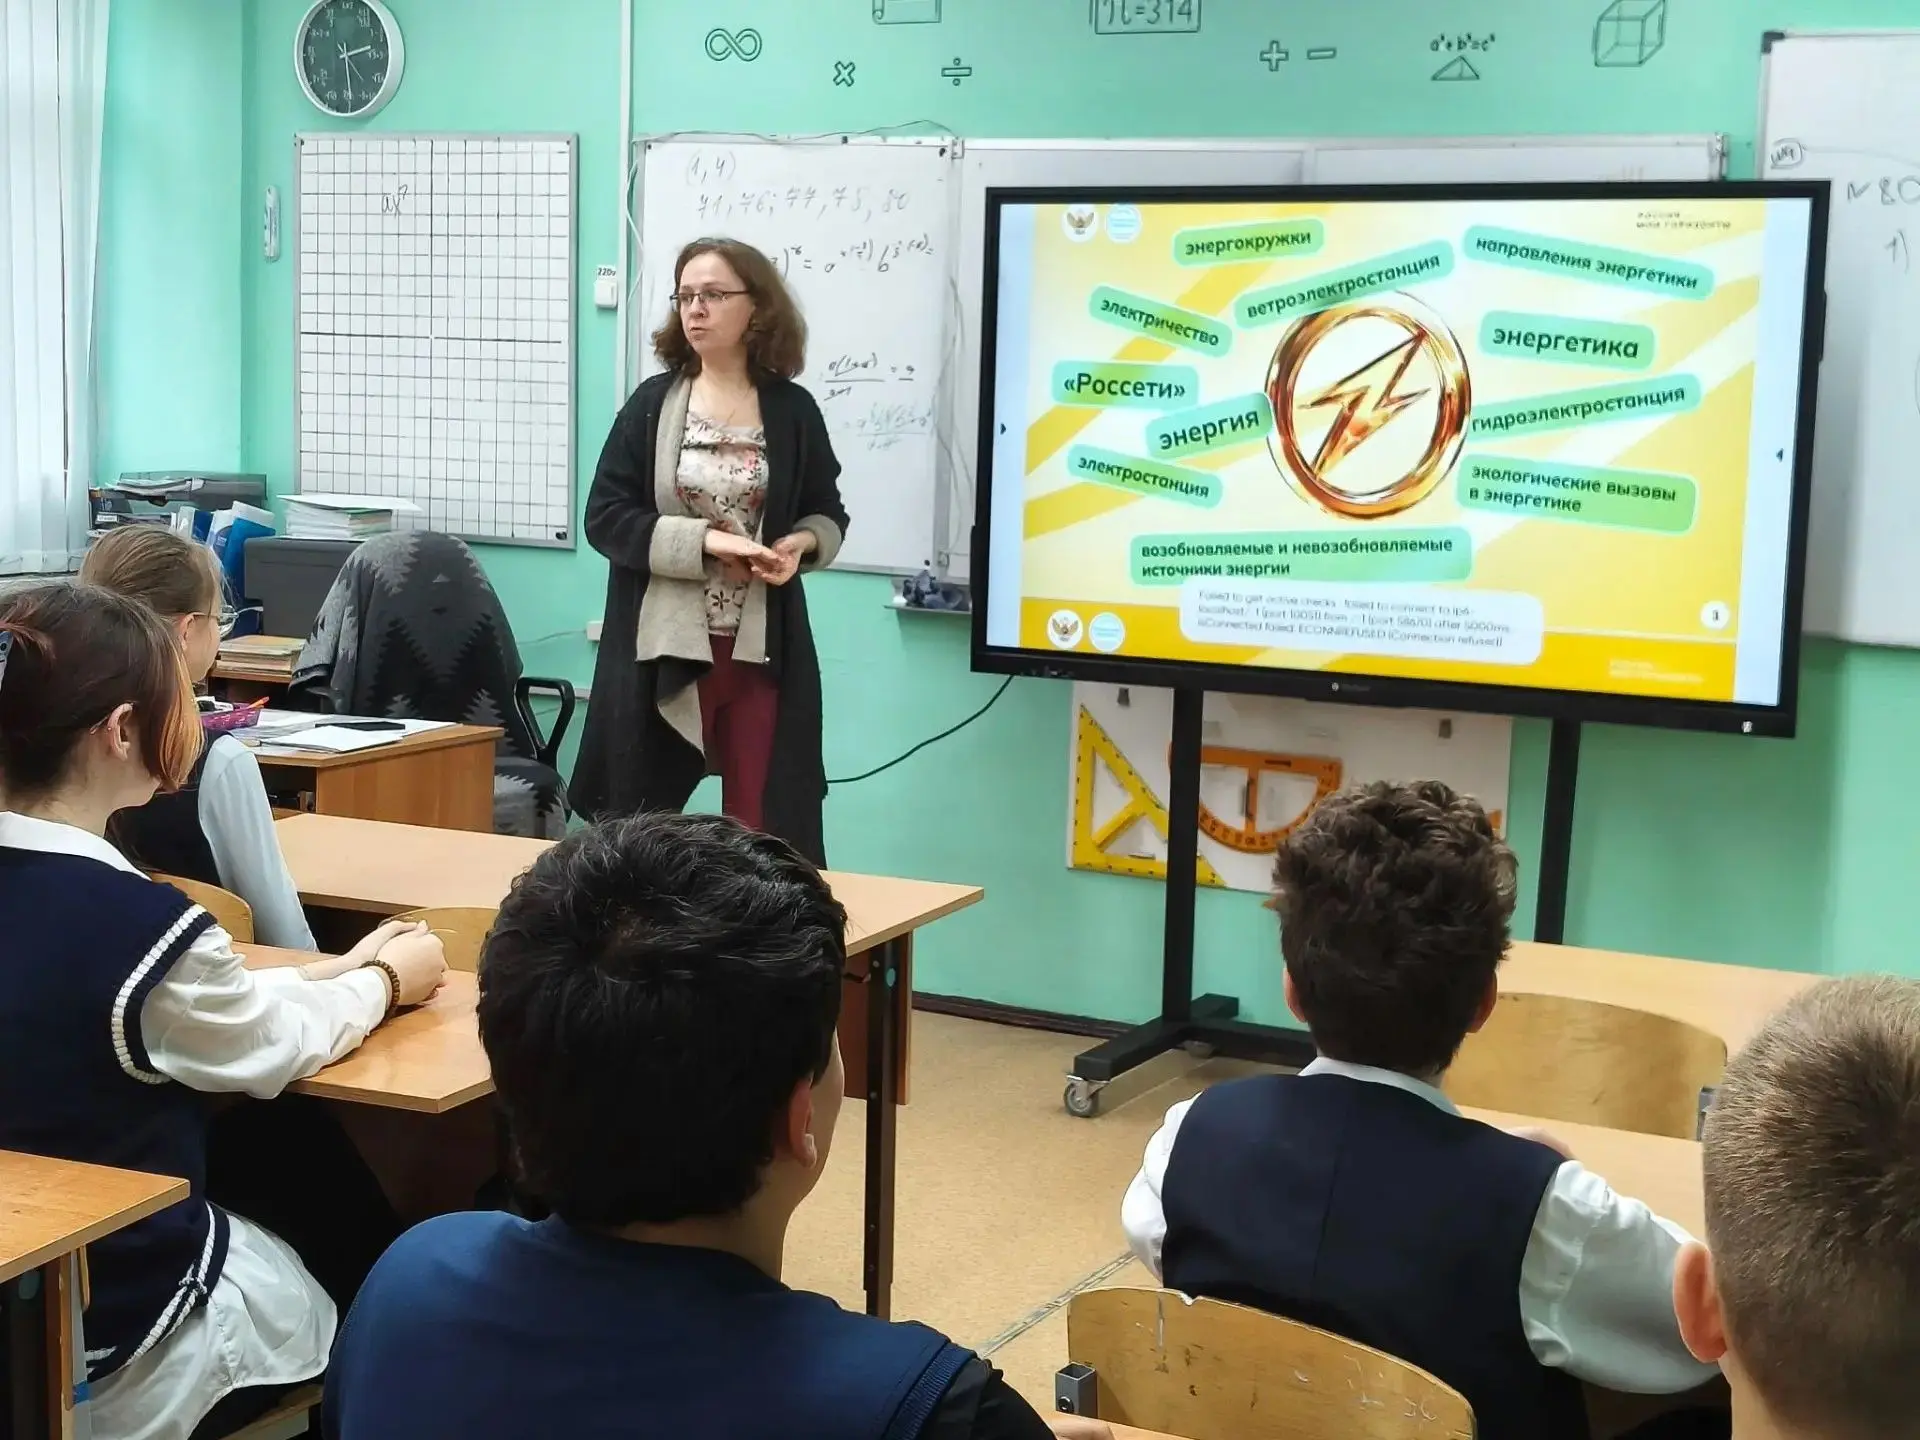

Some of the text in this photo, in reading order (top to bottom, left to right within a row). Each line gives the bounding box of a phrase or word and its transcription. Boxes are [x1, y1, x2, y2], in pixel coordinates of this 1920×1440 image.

[1185, 232, 1311, 256] энергокружки
[1476, 237, 1698, 289] направления энергетики
[1247, 254, 1441, 318] ветроэлектростанция
[1101, 299, 1220, 347] электричество
[1493, 328, 1639, 359] энергетика
[1064, 373, 1186, 399] «Россети»
[1472, 387, 1686, 432] гидроэлектростанция
[1159, 410, 1260, 450] энергия
[1078, 457, 1210, 498] электростанция
[1471, 466, 1677, 502] экологические вызовы
[1484, 488, 1582, 513] энергетике
[1141, 537, 1453, 558] возобновляемые и невозобновляемые
[1141, 563, 1290, 578] источники энергии
